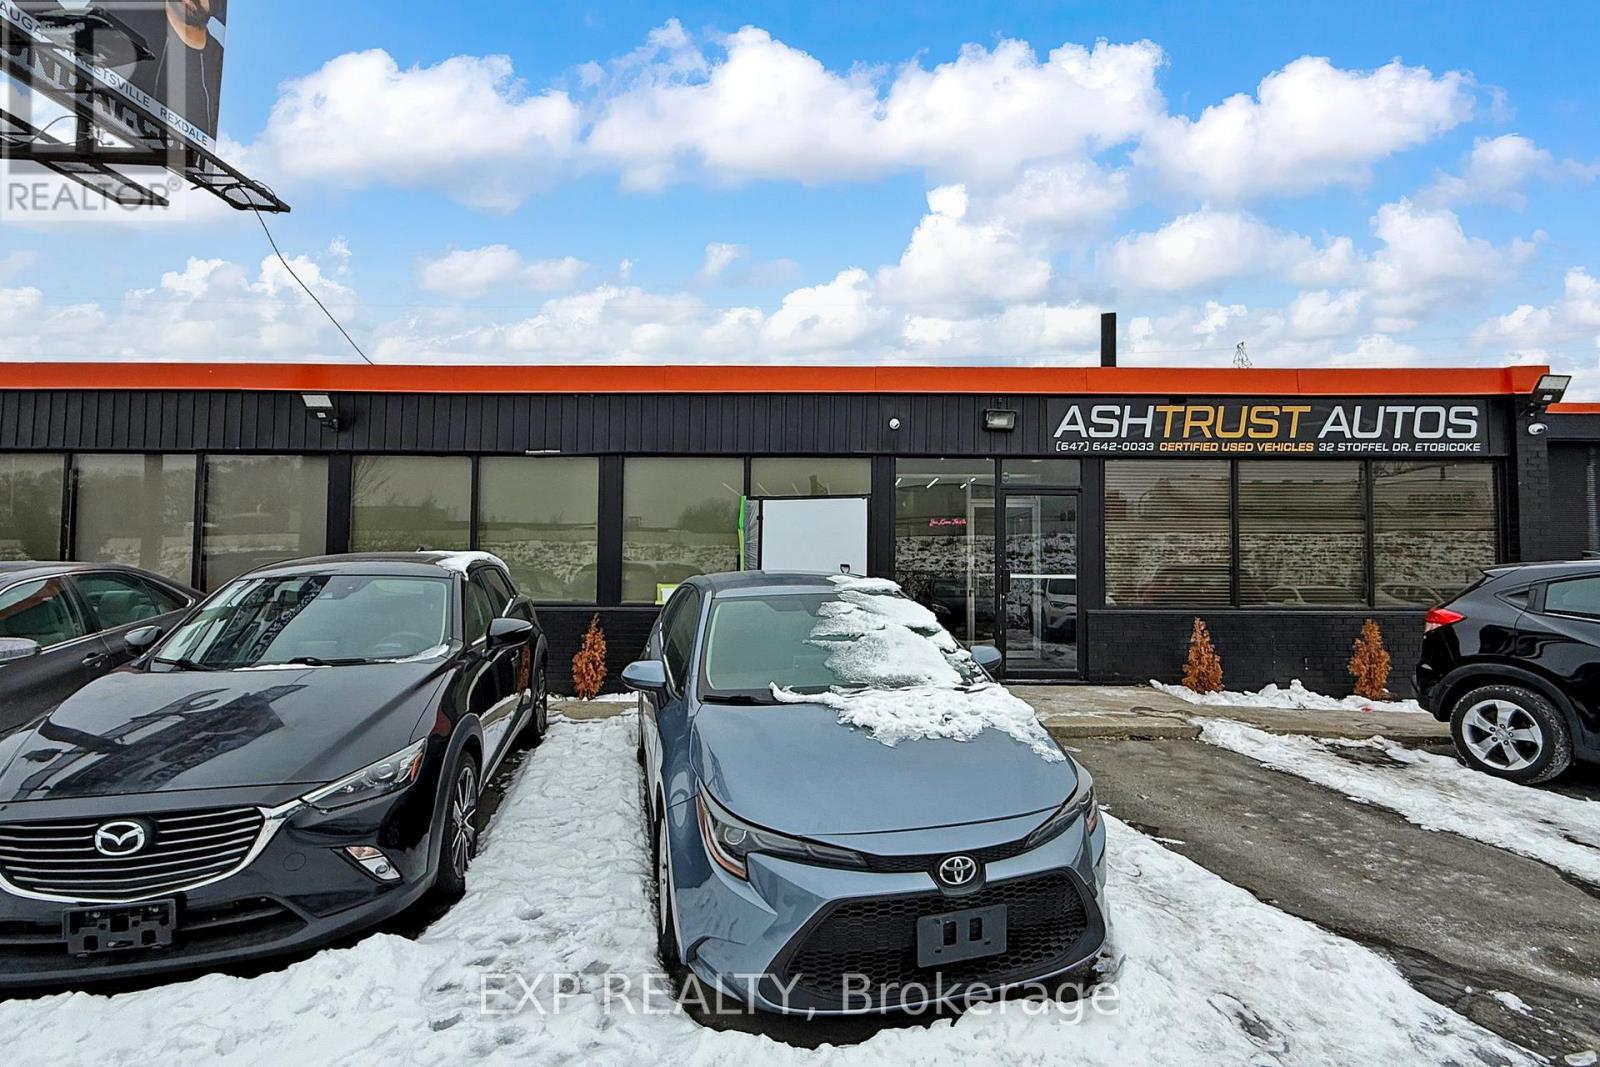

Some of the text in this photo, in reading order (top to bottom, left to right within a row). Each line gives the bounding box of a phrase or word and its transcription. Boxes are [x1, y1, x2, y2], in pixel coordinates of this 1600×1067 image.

[160, 107, 208, 146] REXDALE
[1317, 405, 1479, 439] AUTOS
[1055, 441, 1481, 452] (647) 642-0033 CERTIFIED USED VEHICLES 32 STOFFEL DR. ETOBICOKE
